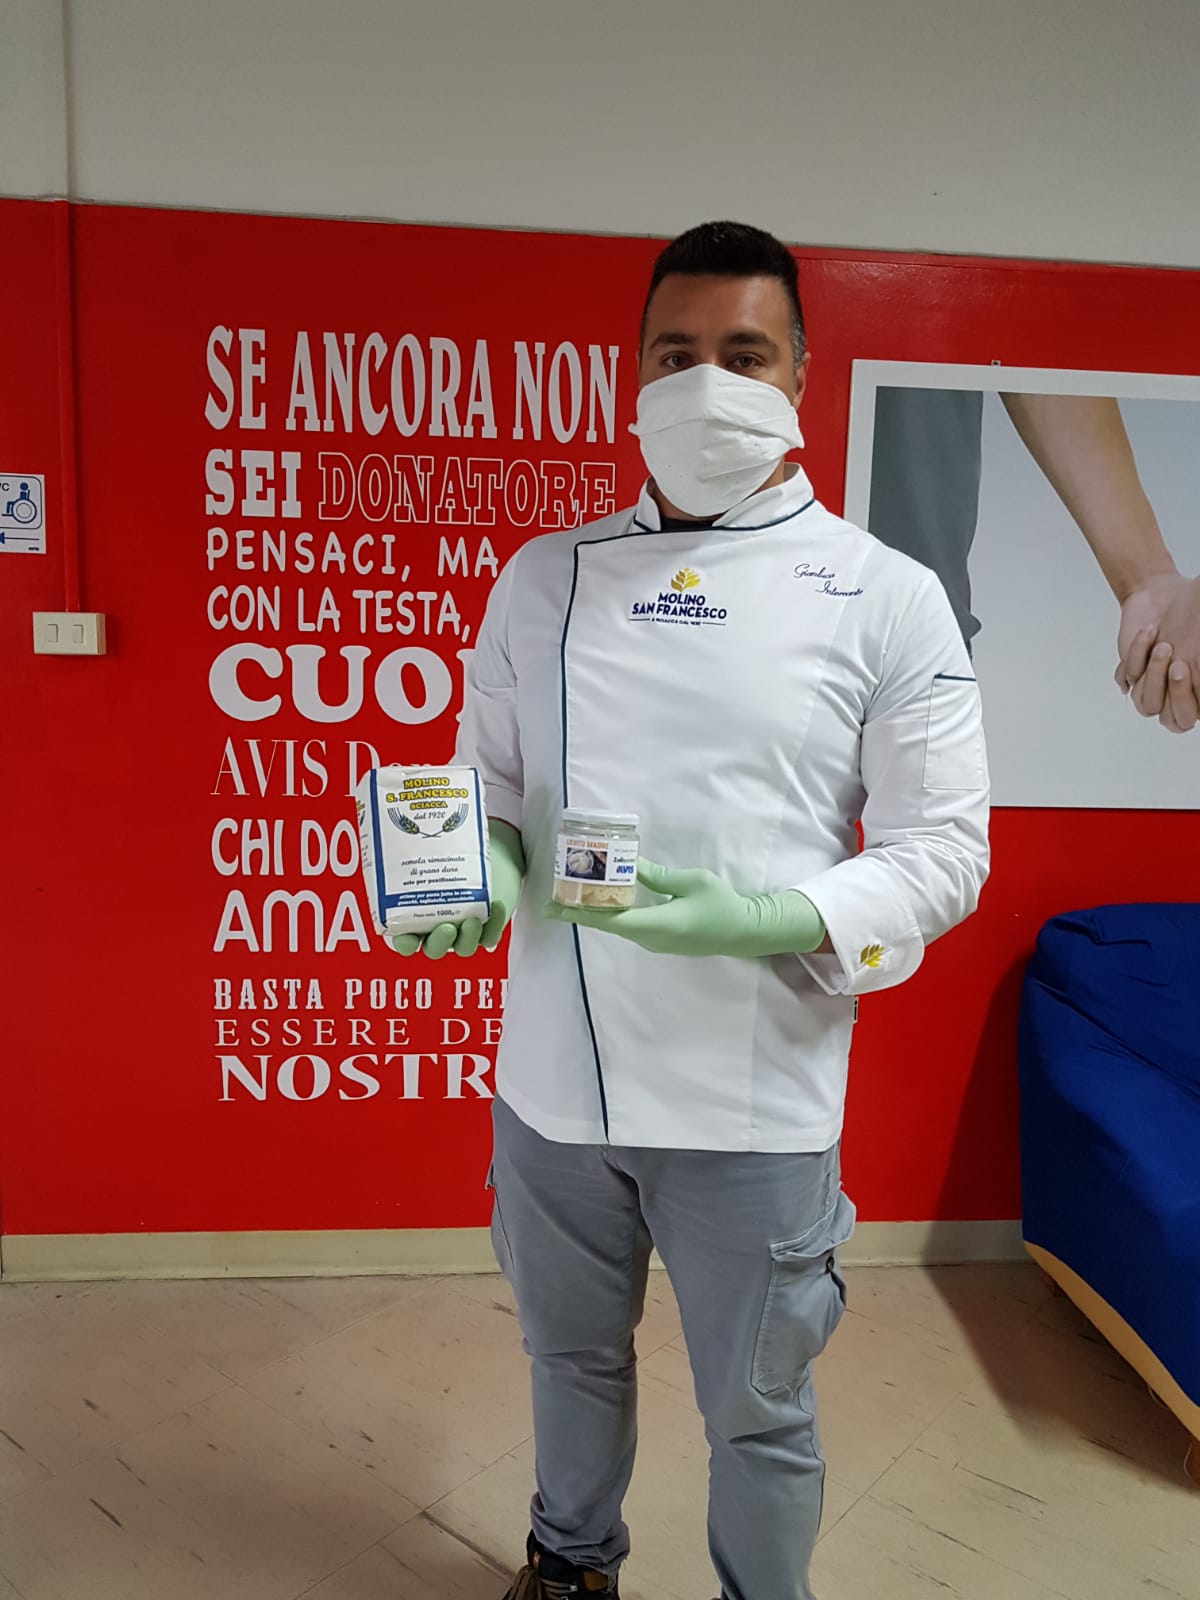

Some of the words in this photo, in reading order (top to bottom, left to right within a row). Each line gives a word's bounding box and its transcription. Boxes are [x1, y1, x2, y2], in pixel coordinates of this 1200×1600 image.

[205, 325, 266, 430] SE
[286, 331, 498, 438] ANCORA
[512, 340, 620, 444] NON
[205, 448, 302, 519] SEI
[318, 451, 616, 528] DONATORE
[207, 526, 411, 582] PENSACI,
[438, 535, 499, 578] MA
[207, 585, 280, 632] CON
[298, 587, 341, 632] LA
[353, 590, 471, 643] TESTA,
[632, 602, 656, 615] SAN
[656, 604, 727, 619] FRANCESCO
[657, 592, 706, 606] MOLINO
[210, 736, 329, 798] AVIS
[403, 777, 450, 789] MOLINO
[386, 793, 398, 803] S.
[399, 788, 469, 802] FRANCESCO
[410, 801, 448, 810] SCIACCA
[211, 818, 285, 876] CHI
[213, 978, 325, 1010] BASTA
[345, 979, 433, 1010] POCO
[215, 1018, 409, 1047] ESSERE
